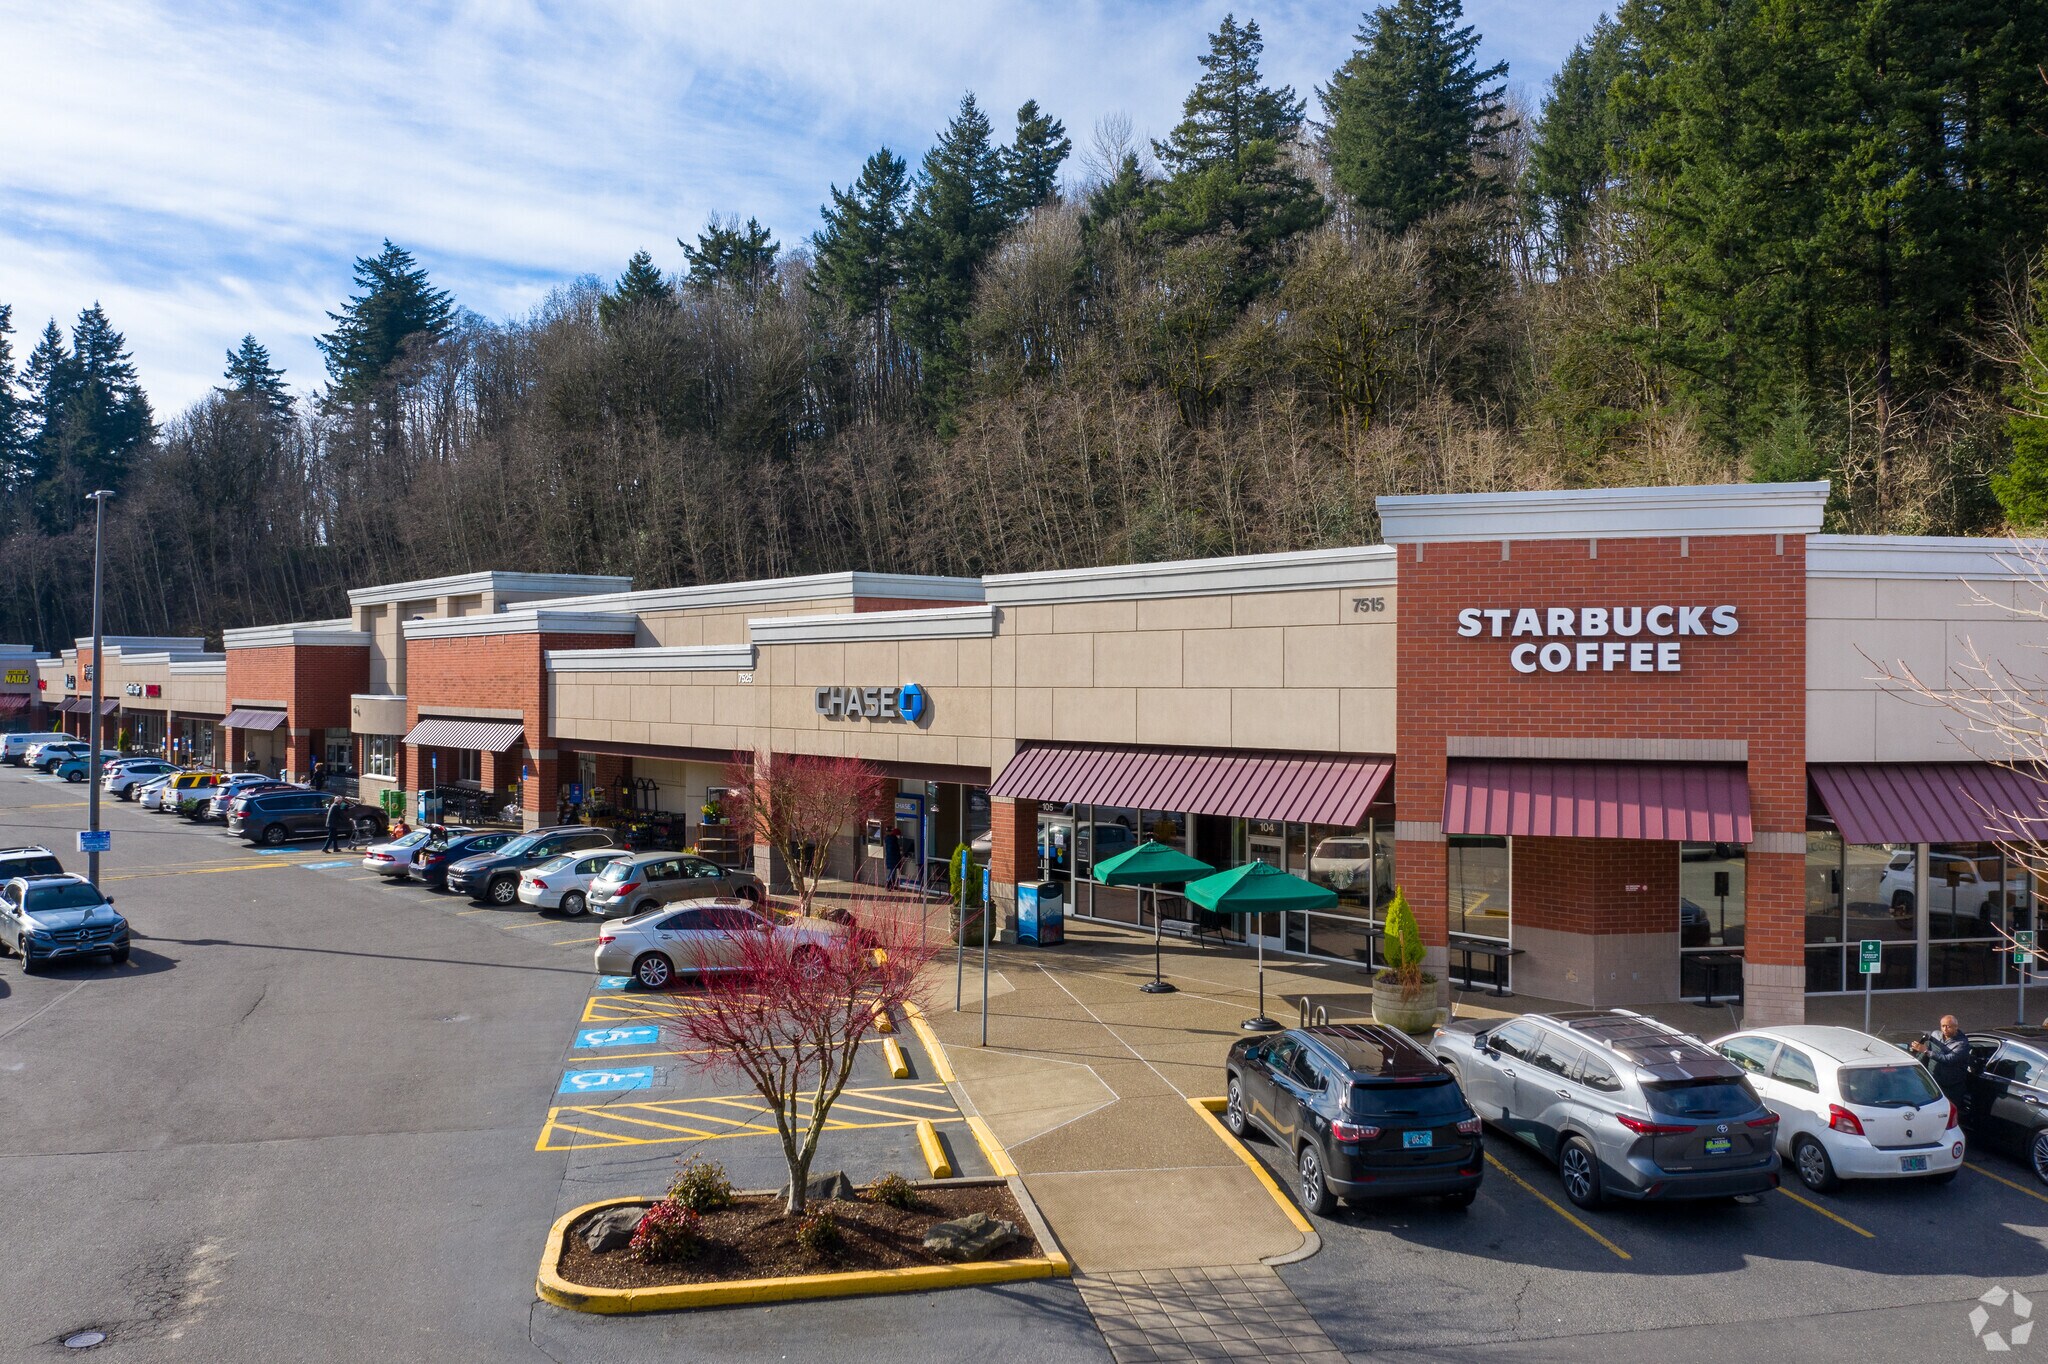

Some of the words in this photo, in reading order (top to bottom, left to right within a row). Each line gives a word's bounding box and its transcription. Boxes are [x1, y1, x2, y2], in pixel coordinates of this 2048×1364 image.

[1352, 597, 1385, 613] 7515
[1457, 605, 1739, 637] STARBUCKS
[1510, 642, 1681, 673] COFFEE
[4, 675, 30, 684] NAILS
[738, 673, 753, 683] 7525
[815, 687, 896, 718] CHASE
[1042, 803, 1054, 812] 105
[1259, 823, 1275, 833] 104
